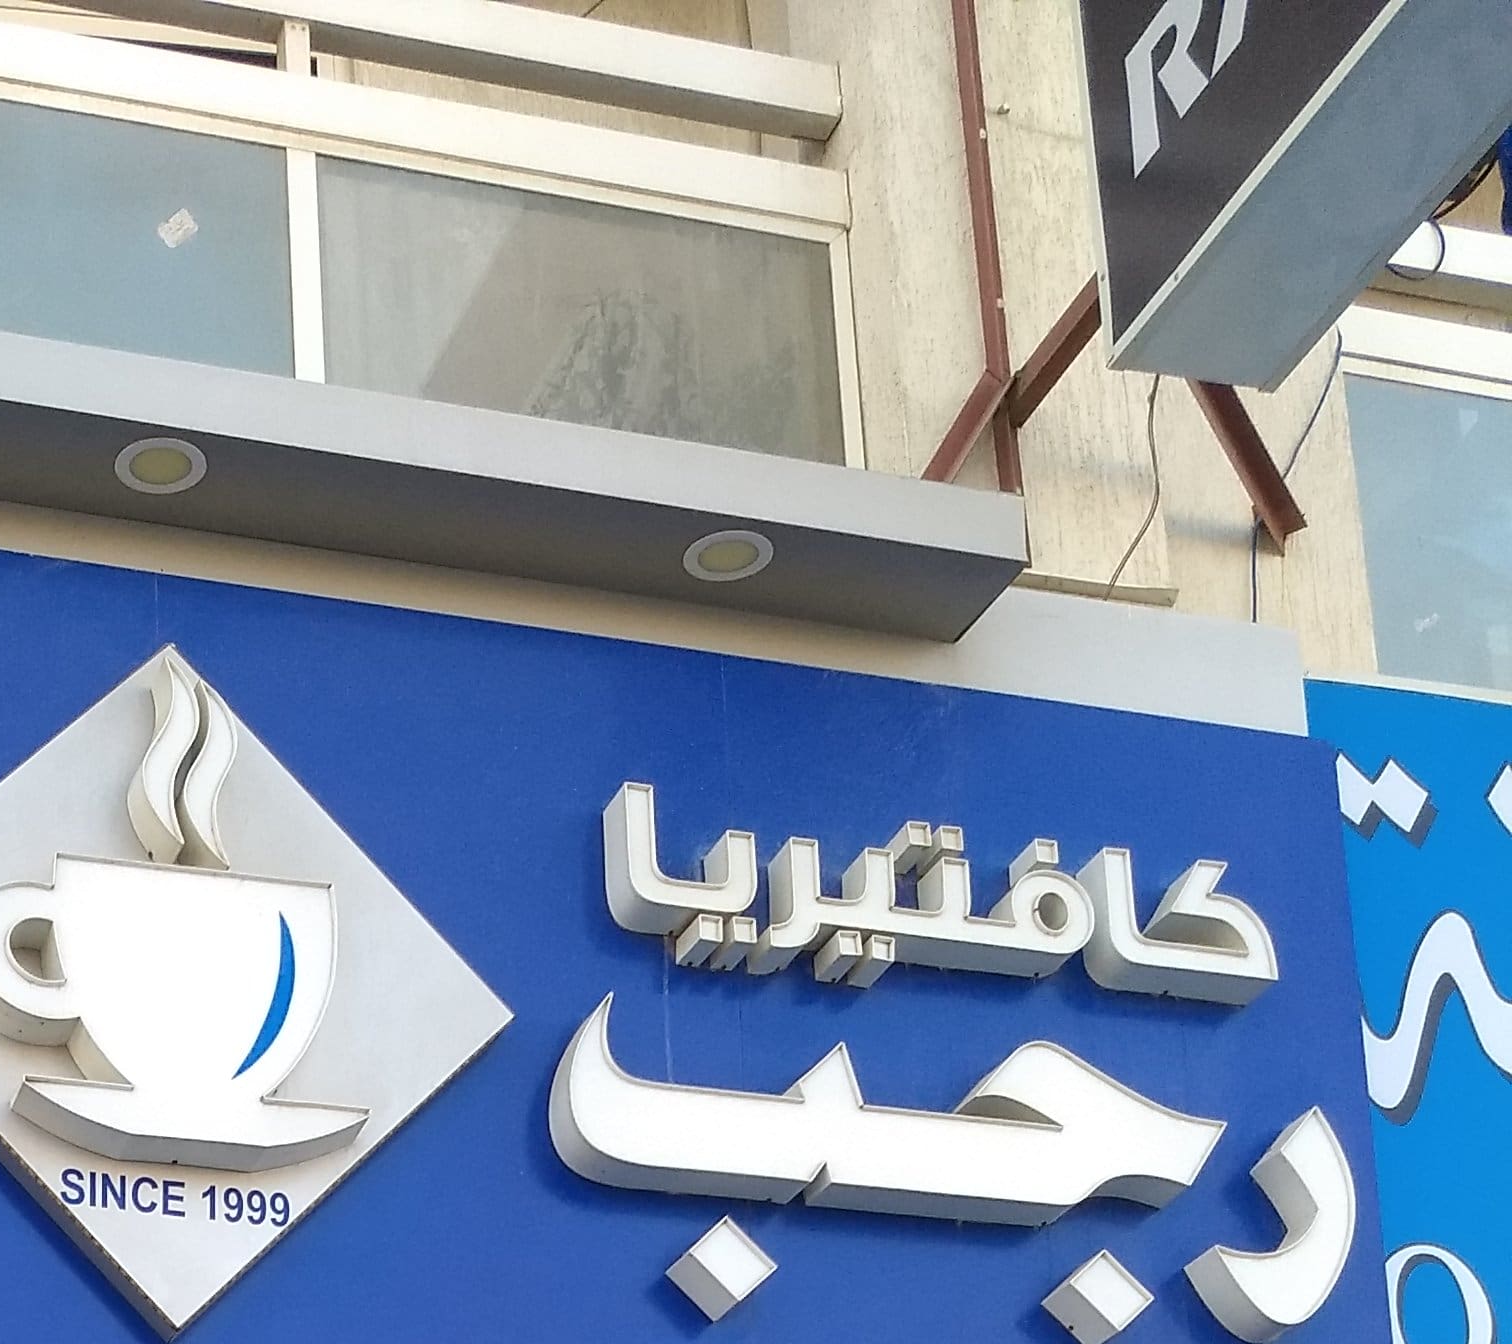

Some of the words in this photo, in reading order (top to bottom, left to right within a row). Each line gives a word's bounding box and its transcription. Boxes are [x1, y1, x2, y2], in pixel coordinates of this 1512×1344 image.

[602, 780, 1279, 1006] كافتيريا
[60, 1167, 186, 1219] SINCE
[200, 1185, 290, 1228] 1999
